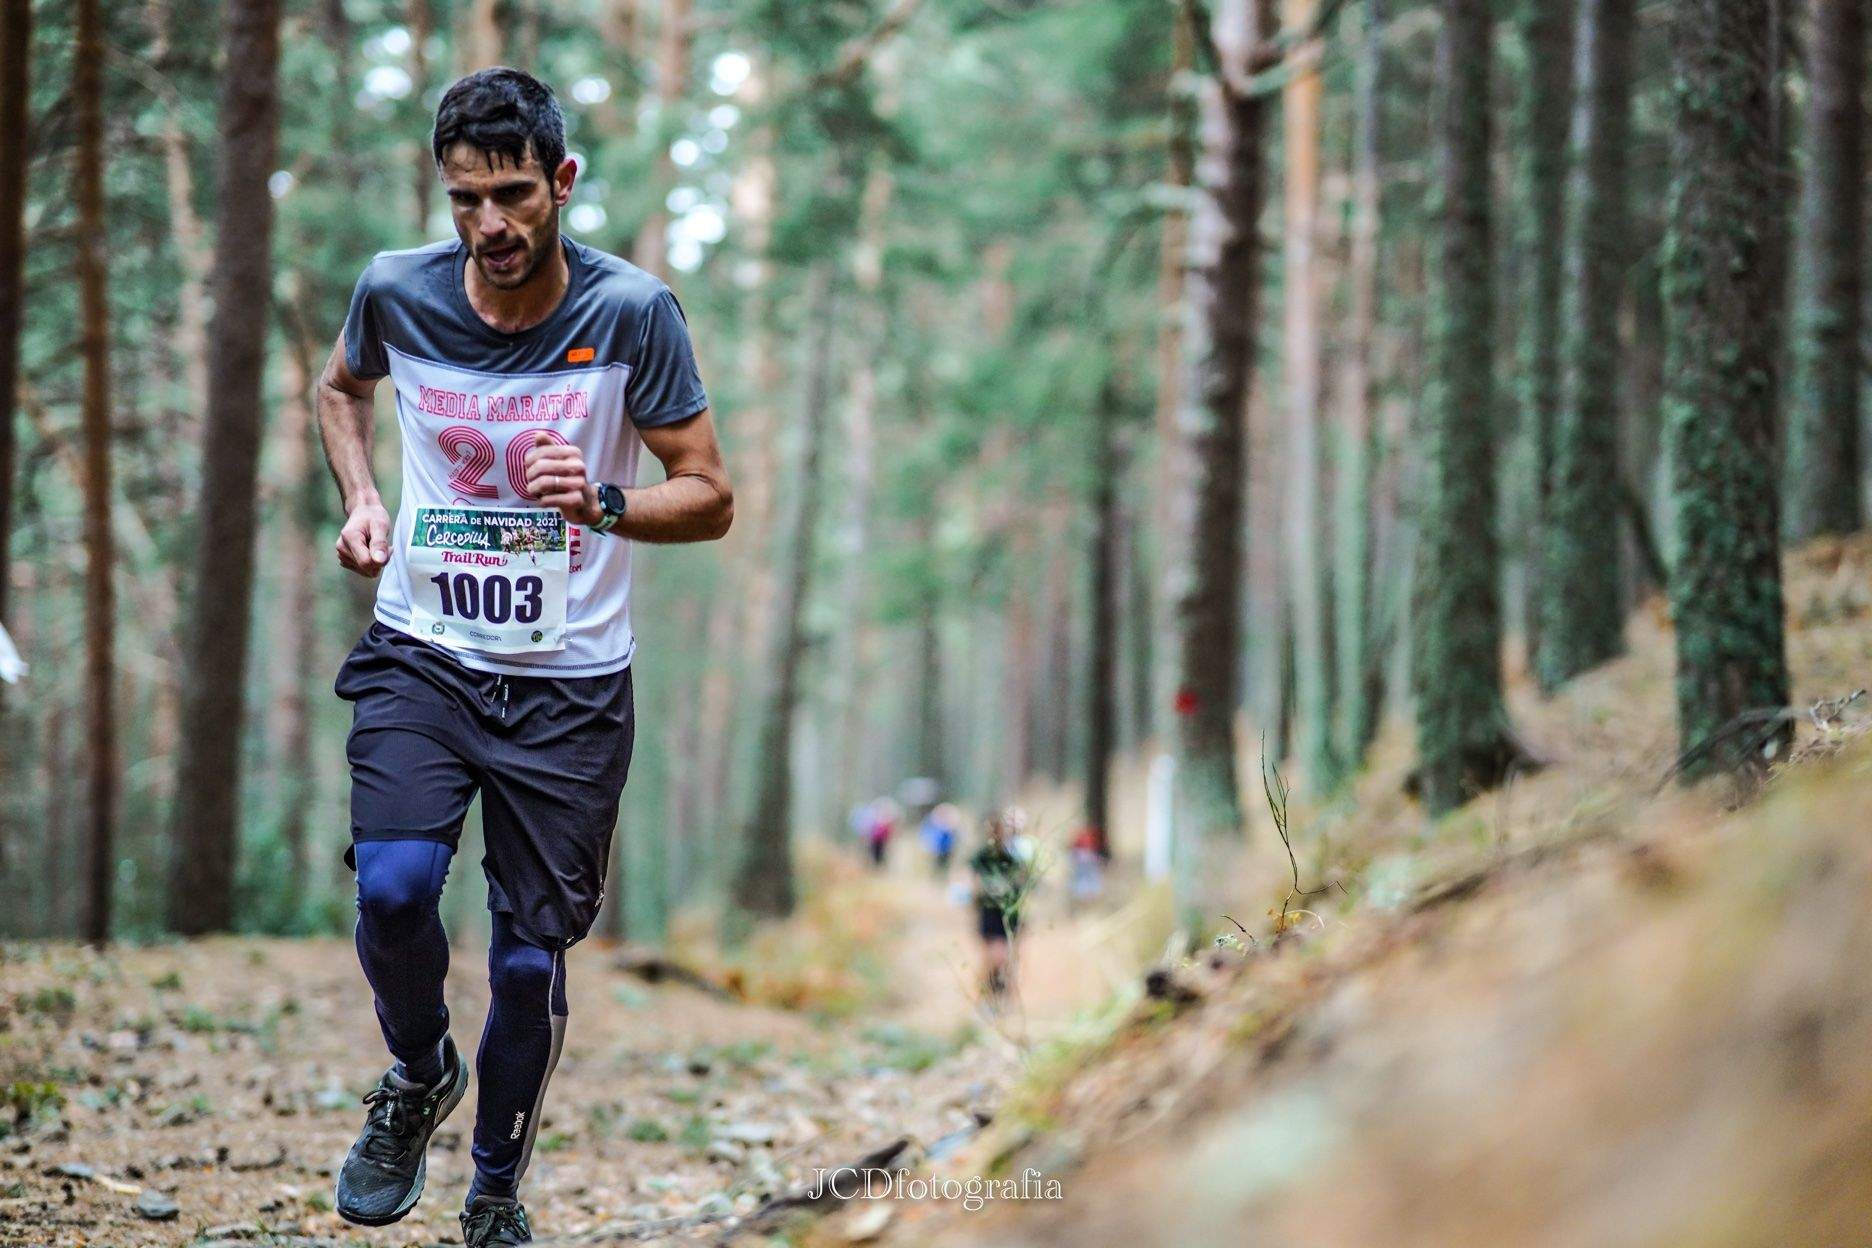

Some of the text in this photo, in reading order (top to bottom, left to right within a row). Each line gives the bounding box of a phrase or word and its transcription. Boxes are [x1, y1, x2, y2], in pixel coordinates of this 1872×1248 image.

[419, 384, 588, 421] MEDIA MARATÓN
[422, 514, 558, 527] CARRERA DE NAVIDAD 2021
[441, 551, 473, 564] Trail
[430, 572, 543, 624] 1003
[510, 1111, 525, 1139] Reebok
